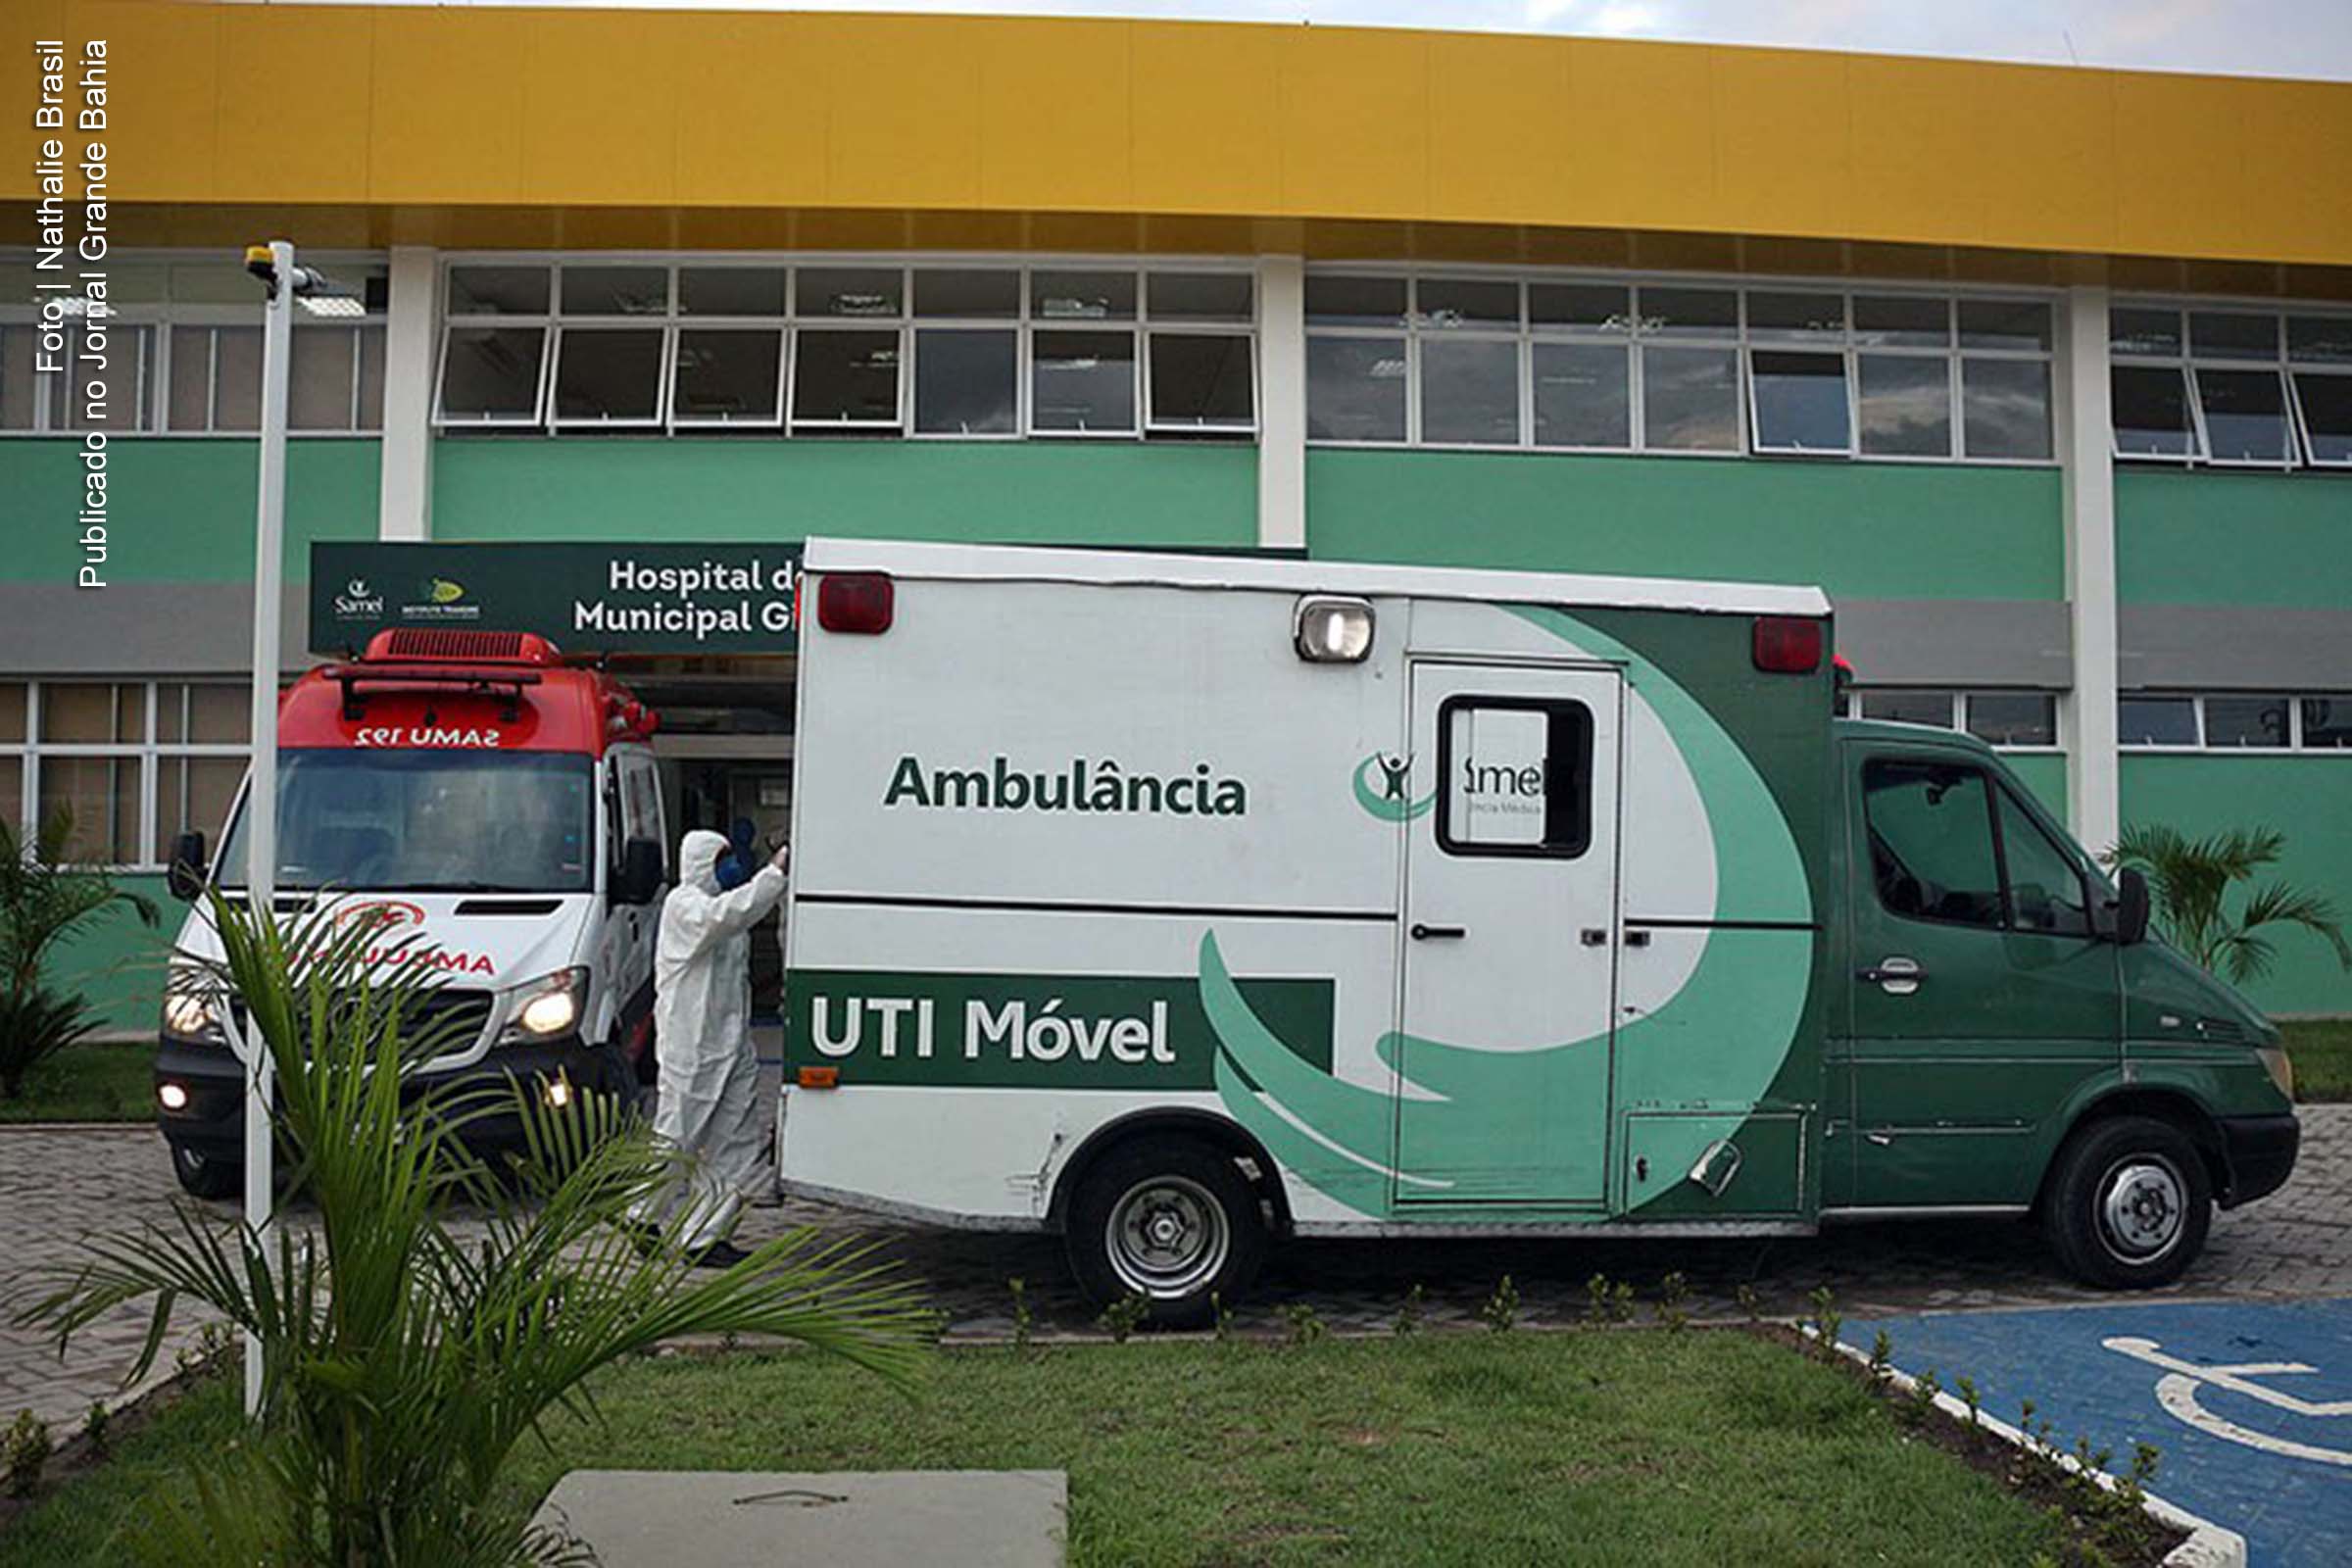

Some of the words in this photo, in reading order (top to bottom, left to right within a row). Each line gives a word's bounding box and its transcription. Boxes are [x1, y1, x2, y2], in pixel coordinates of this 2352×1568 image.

[609, 560, 763, 600] Hospital
[771, 560, 795, 590] d
[573, 601, 753, 640] Municipal
[884, 757, 1247, 815] Ambulância
[811, 997, 934, 1057] UTI
[964, 998, 1176, 1063] Móvel
